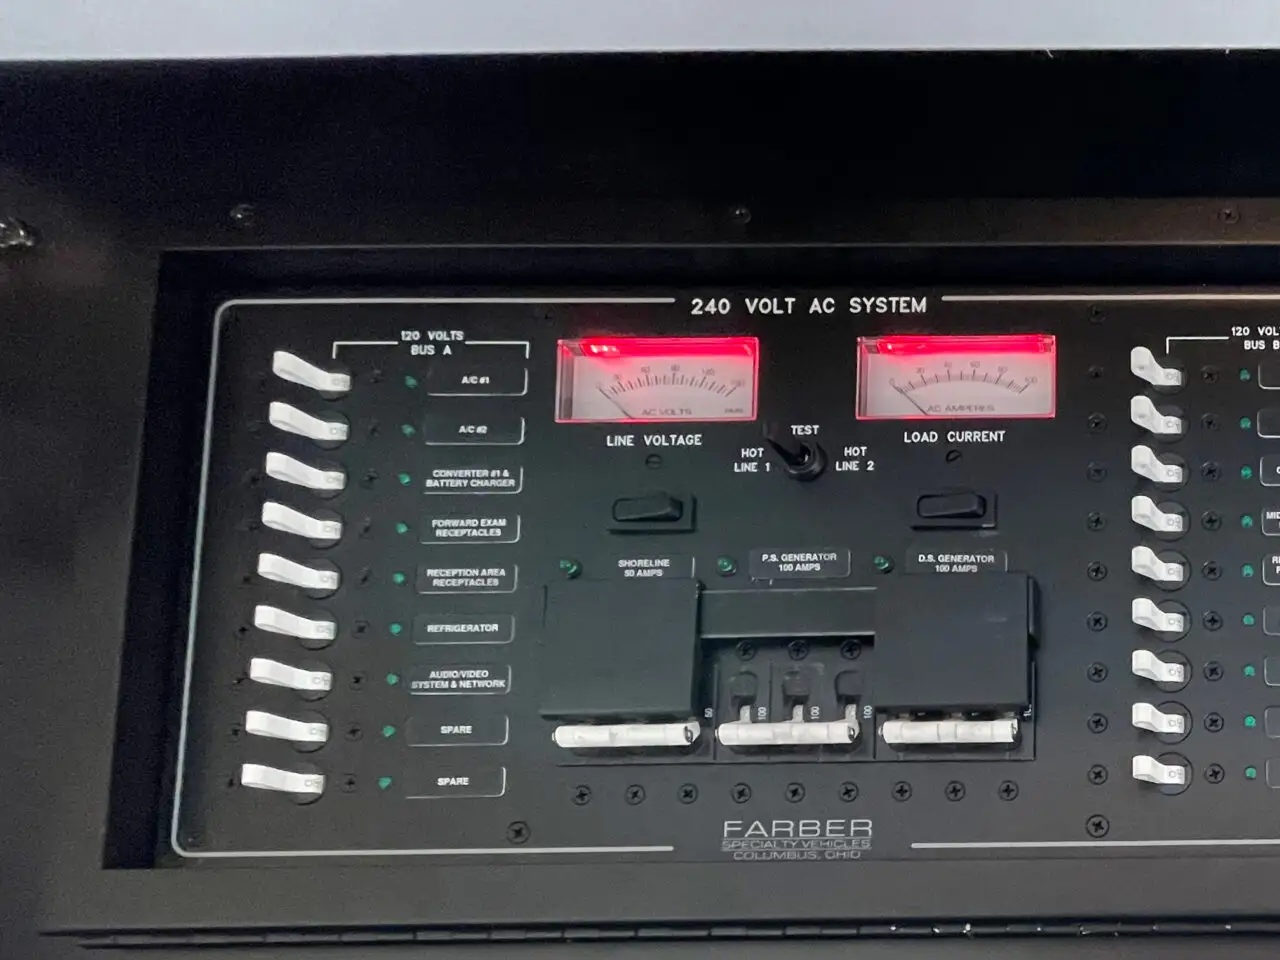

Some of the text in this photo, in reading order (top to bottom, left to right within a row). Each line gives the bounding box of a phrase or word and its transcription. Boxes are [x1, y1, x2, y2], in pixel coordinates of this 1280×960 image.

[691, 297, 927, 315] 240 VOLT AC SYSTEM
[401, 331, 464, 341] 120 VOLTS
[1231, 327, 1250, 336] 120
[1244, 340, 1280, 350] BUS B
[411, 345, 452, 355] BUS A
[461, 376, 478, 385] A/C
[458, 425, 474, 434] A/C
[791, 425, 819, 435] TEST
[607, 434, 702, 447] LINE VOLTAGE
[904, 430, 1005, 443] LOAD CURRENT
[741, 448, 764, 458] HOT
[844, 447, 867, 456] HOT
[734, 463, 760, 472] LINE
[835, 461, 875, 471] LINE 2
[433, 470, 488, 478] CONVERTER
[426, 479, 515, 488] BATTERY CHARGER
[431, 518, 506, 527] FORWARD EXAM
[435, 528, 502, 537] RECEPTACLES
[762, 553, 837, 562] P.S. GENERATOR
[918, 554, 995, 563] D.S. GENERATOR
[618, 559, 670, 568] SHORELINE
[779, 562, 821, 571] 100 AMPS
[426, 568, 506, 577] RECEPTION AREA
[637, 569, 663, 577] AMPS
[935, 565, 978, 573] 100 AMPS
[432, 578, 498, 587] RECEPTACLES
[427, 623, 499, 632] REFRIGERATOR
[429, 670, 489, 679] AUDIO/VIDEO
[411, 680, 449, 689] SYSTEM
[459, 679, 506, 688] NETWORK
[863, 705, 873, 719] 100
[440, 725, 472, 734] SPARE
[437, 777, 469, 786] SPARE
[723, 819, 873, 838] FARBER
[722, 839, 870, 849] SPECIALTY VEHICLES
[733, 850, 860, 861] COLUMBUS, OHIO
